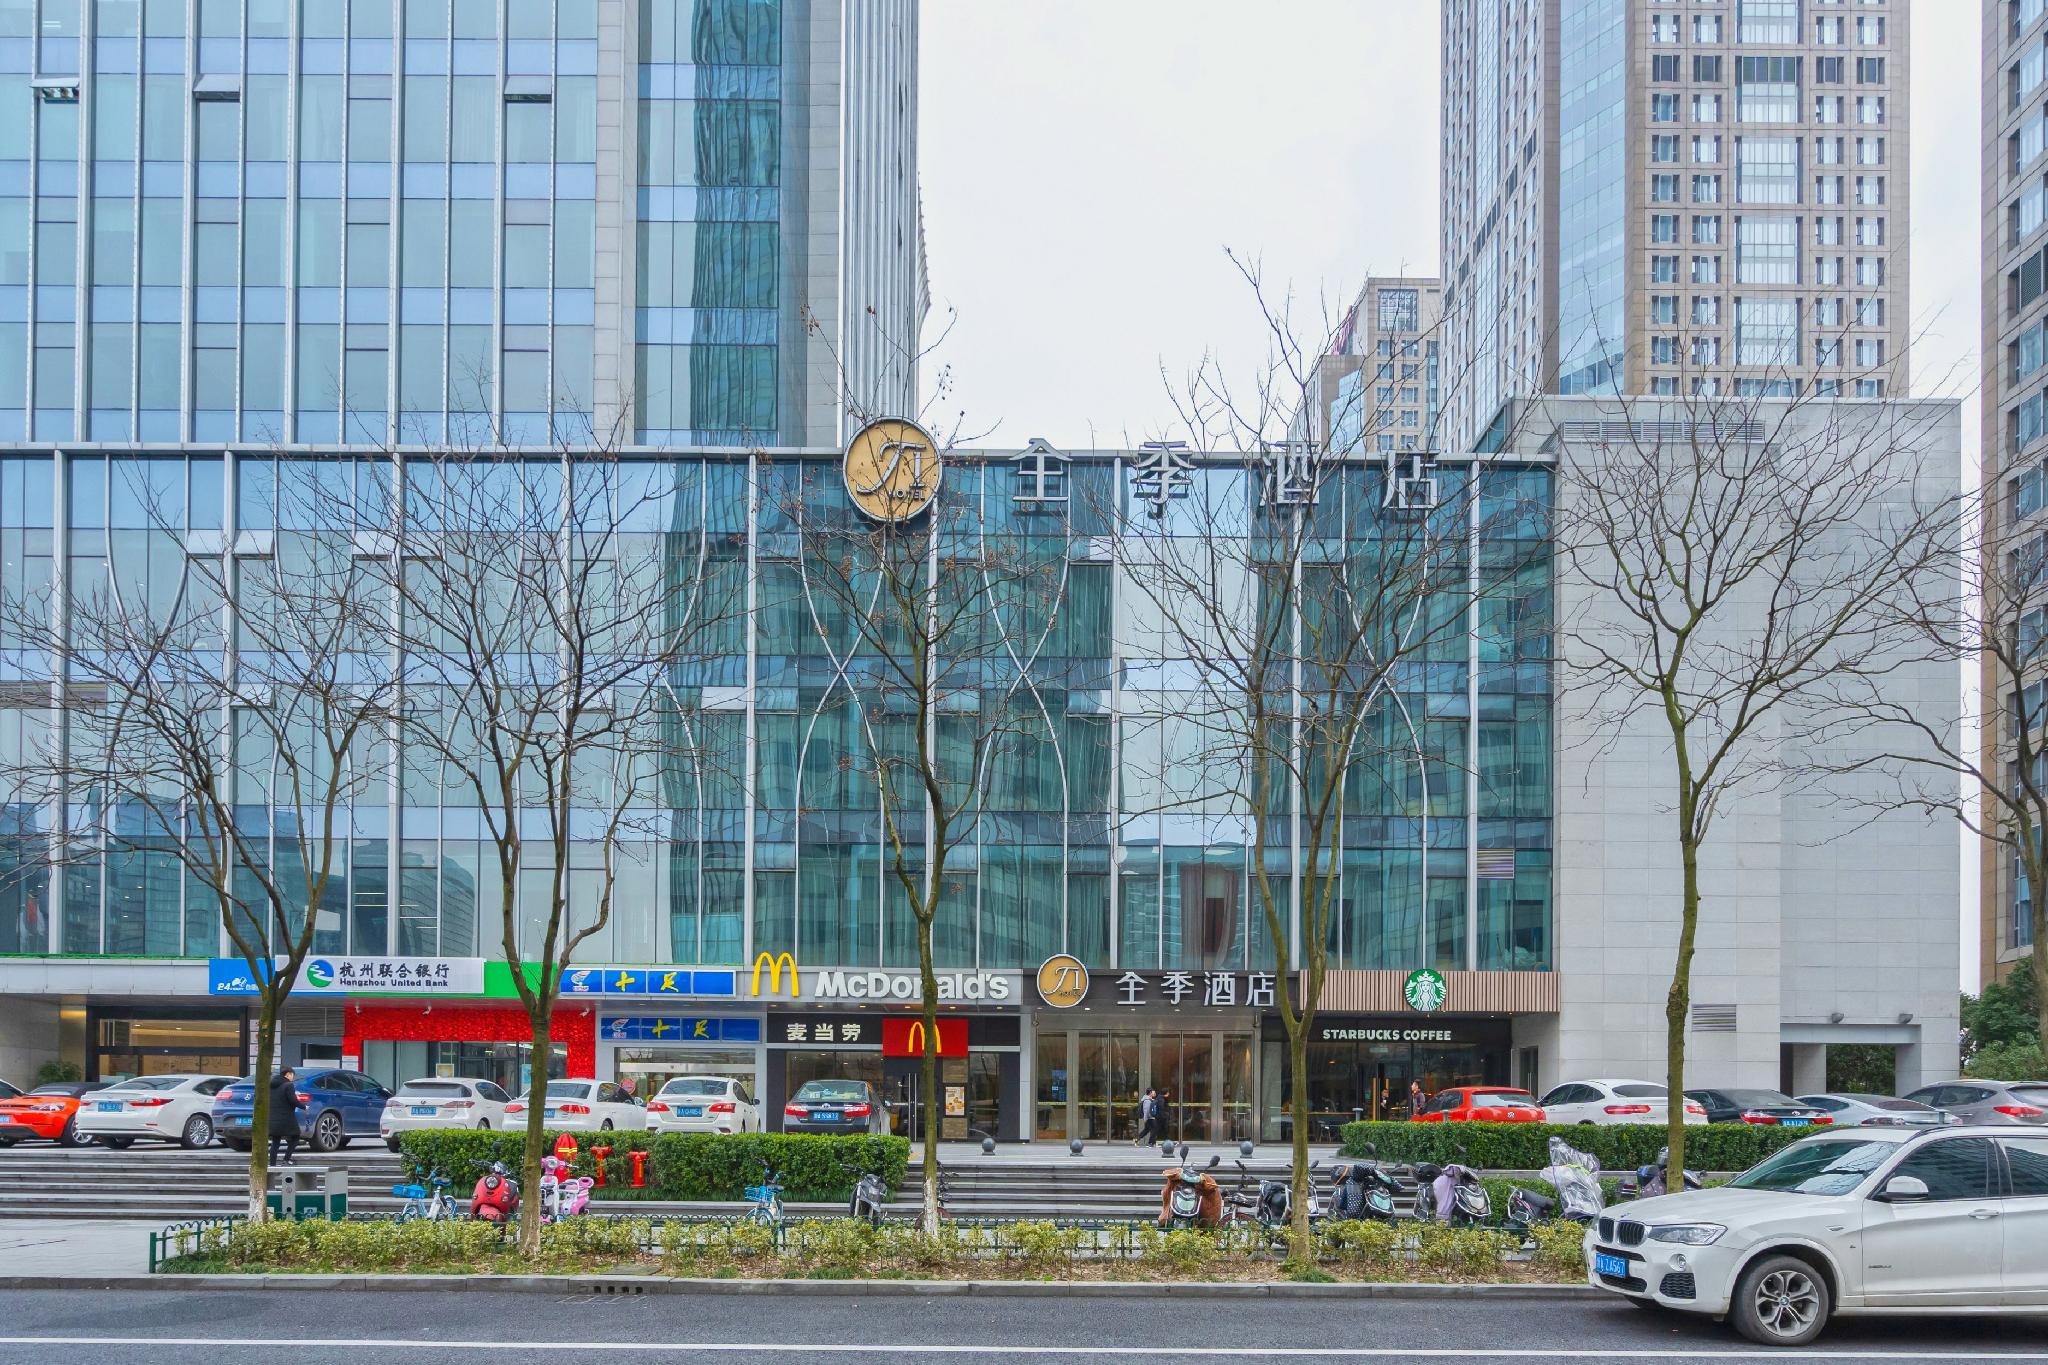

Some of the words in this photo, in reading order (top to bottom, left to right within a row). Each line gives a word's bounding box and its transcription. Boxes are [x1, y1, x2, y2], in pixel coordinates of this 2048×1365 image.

[340, 962, 449, 978] 杭州联合银行
[340, 978, 386, 988] Hangzhou
[391, 979, 421, 987] United
[425, 979, 448, 987] Bank
[814, 971, 1009, 1000] McDoald's
[1115, 971, 1276, 1007] 全季酒店
[786, 1023, 861, 1042] 麦当劳
[1322, 1029, 1400, 1040] STARBUCKS
[1403, 1030, 1452, 1041] COFFEE
